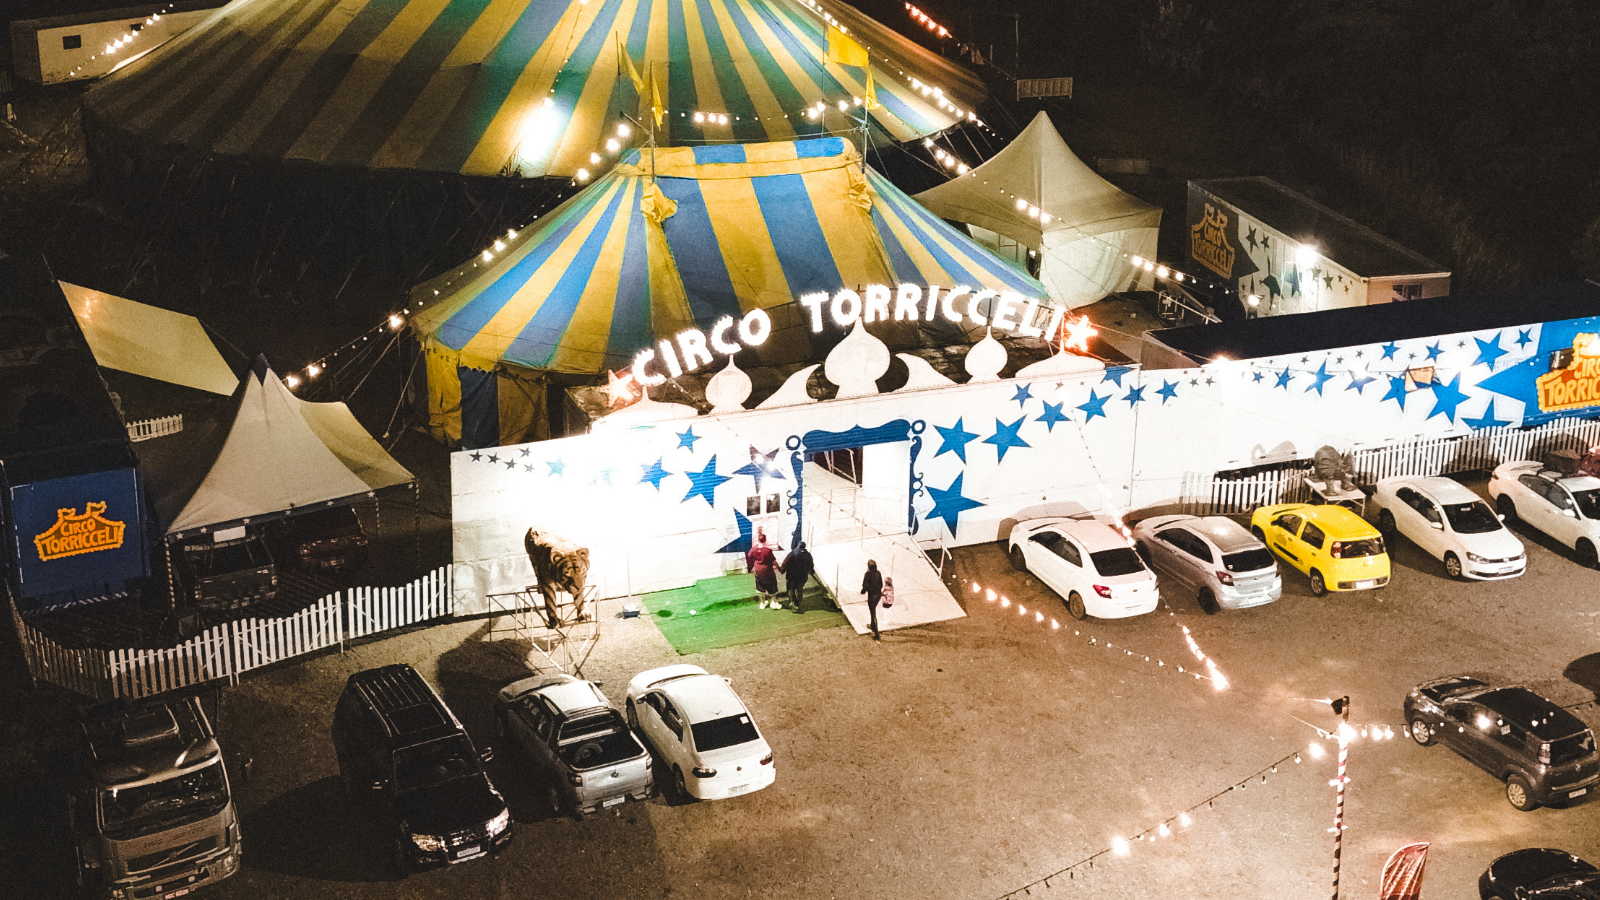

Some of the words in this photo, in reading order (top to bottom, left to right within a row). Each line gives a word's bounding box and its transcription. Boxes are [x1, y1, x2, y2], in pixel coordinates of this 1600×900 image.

[1204, 222, 1221, 247] CIRCO
[632, 308, 772, 387] CIRCO
[801, 284, 1066, 341] TORRICCELI
[41, 526, 118, 554] TORRICCELI
[60, 518, 96, 536] CIRCO
